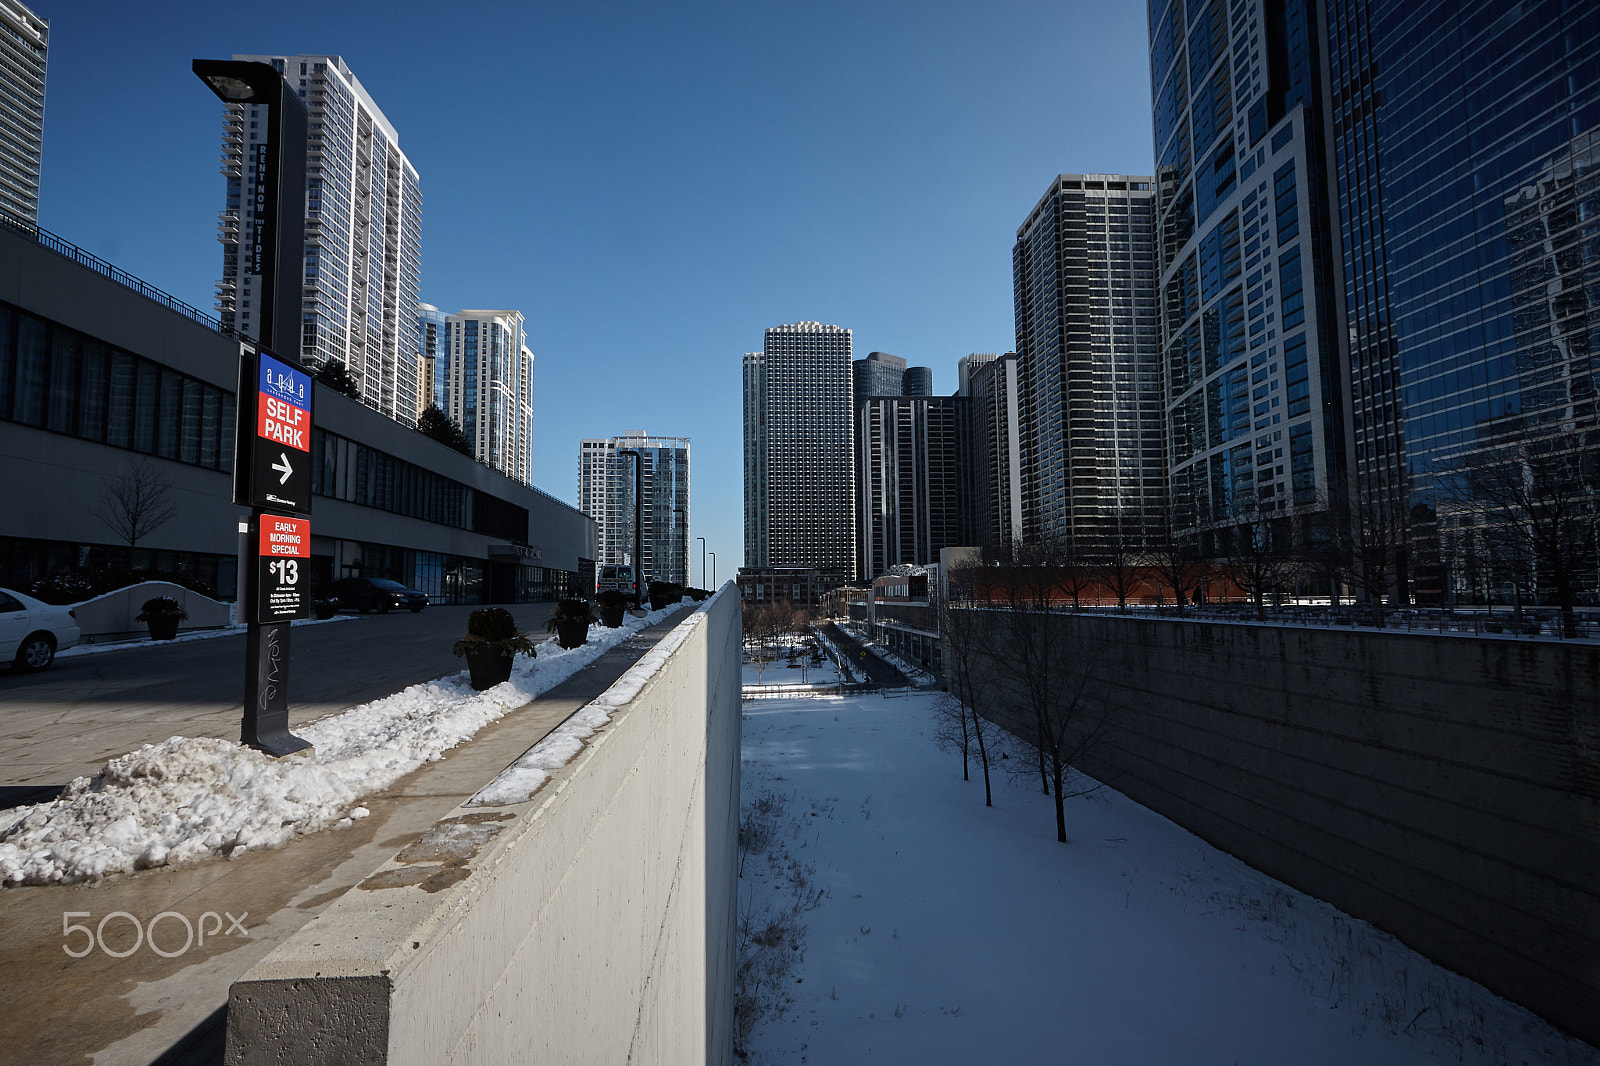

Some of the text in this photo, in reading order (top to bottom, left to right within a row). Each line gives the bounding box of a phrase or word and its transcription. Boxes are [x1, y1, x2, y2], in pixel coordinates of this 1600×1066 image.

[258, 145, 267, 181] RENT
[256, 184, 265, 212] NOW
[255, 226, 263, 272] TIDES
[266, 397, 303, 426] SELF
[264, 418, 303, 449] PARK
[269, 532, 301, 544] MORNING
[275, 521, 297, 533] EARLY
[271, 544, 300, 555] SPECIAL
[269, 559, 299, 585] $13
